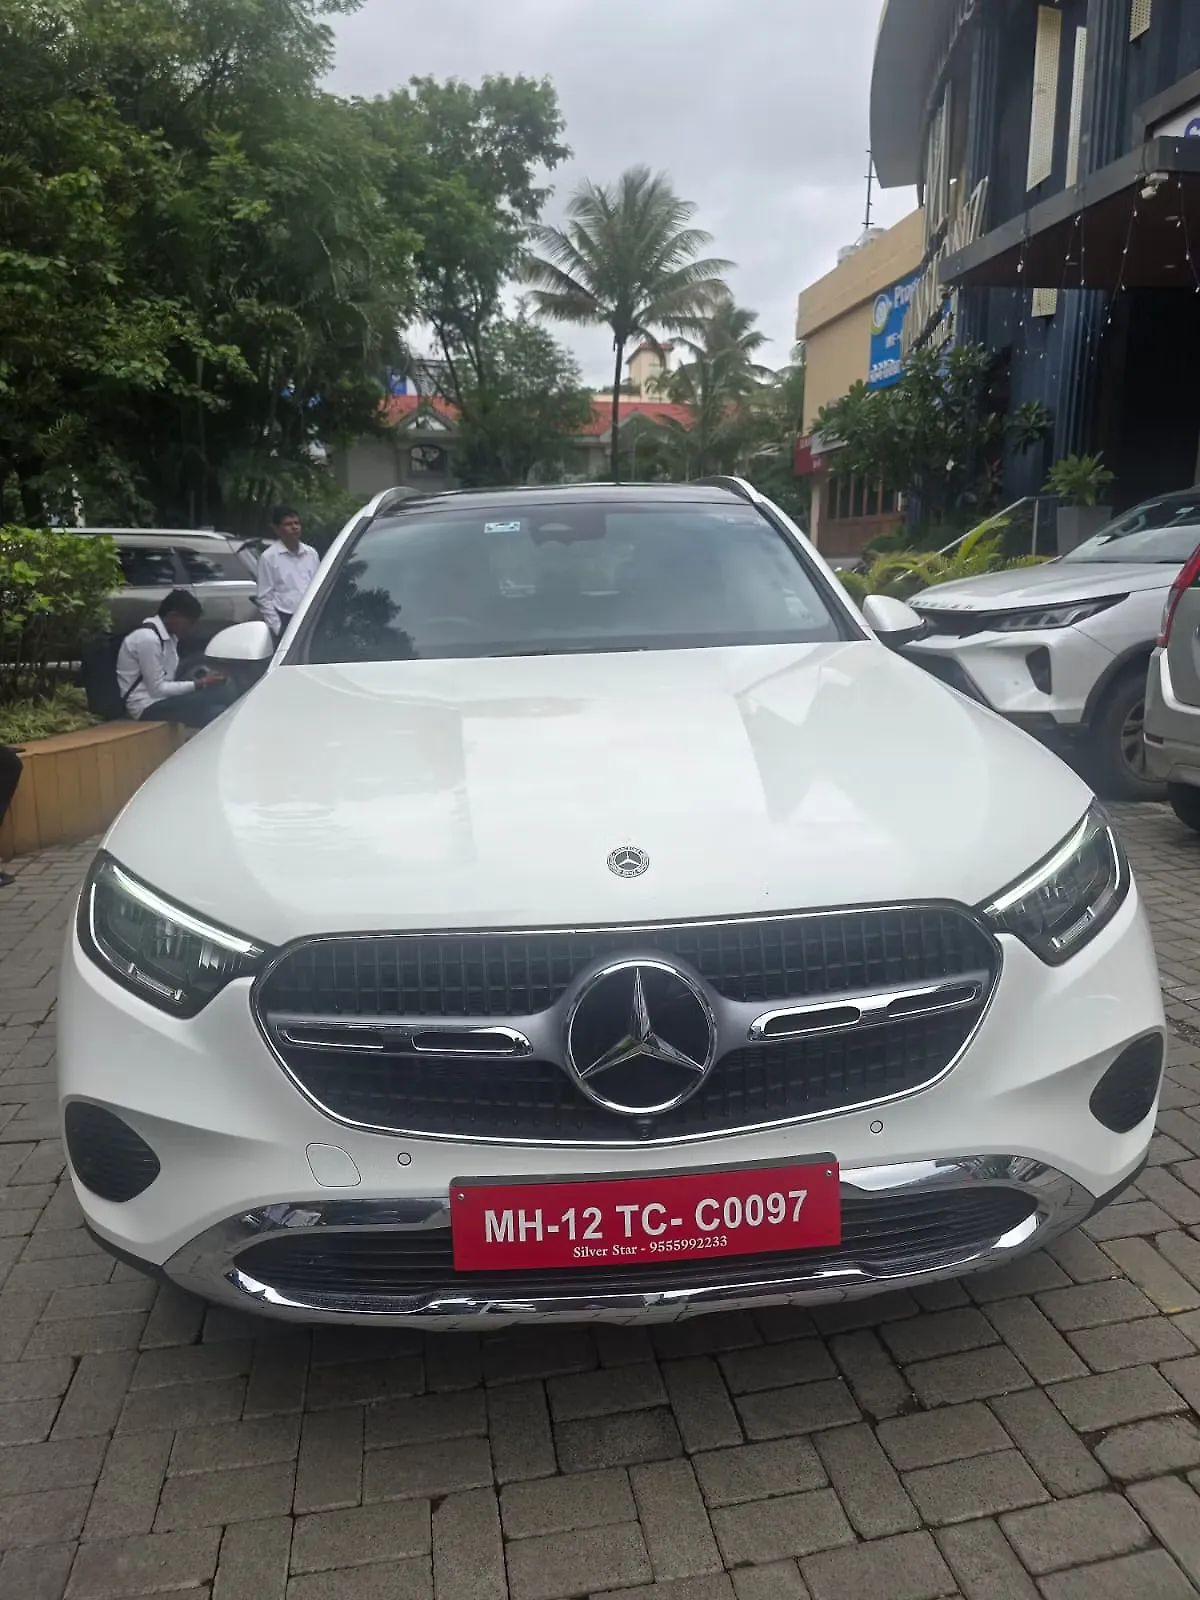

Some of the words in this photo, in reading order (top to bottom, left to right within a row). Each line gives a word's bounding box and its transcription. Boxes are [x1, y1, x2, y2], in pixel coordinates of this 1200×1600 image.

[484, 1206, 603, 1243] MH-12
[615, 1202, 683, 1238] TC-
[694, 1189, 808, 1232] C0097
[573, 1246, 609, 1258] Silver
[612, 1244, 638, 1256] Star
[649, 1235, 728, 1253] 9555992233
